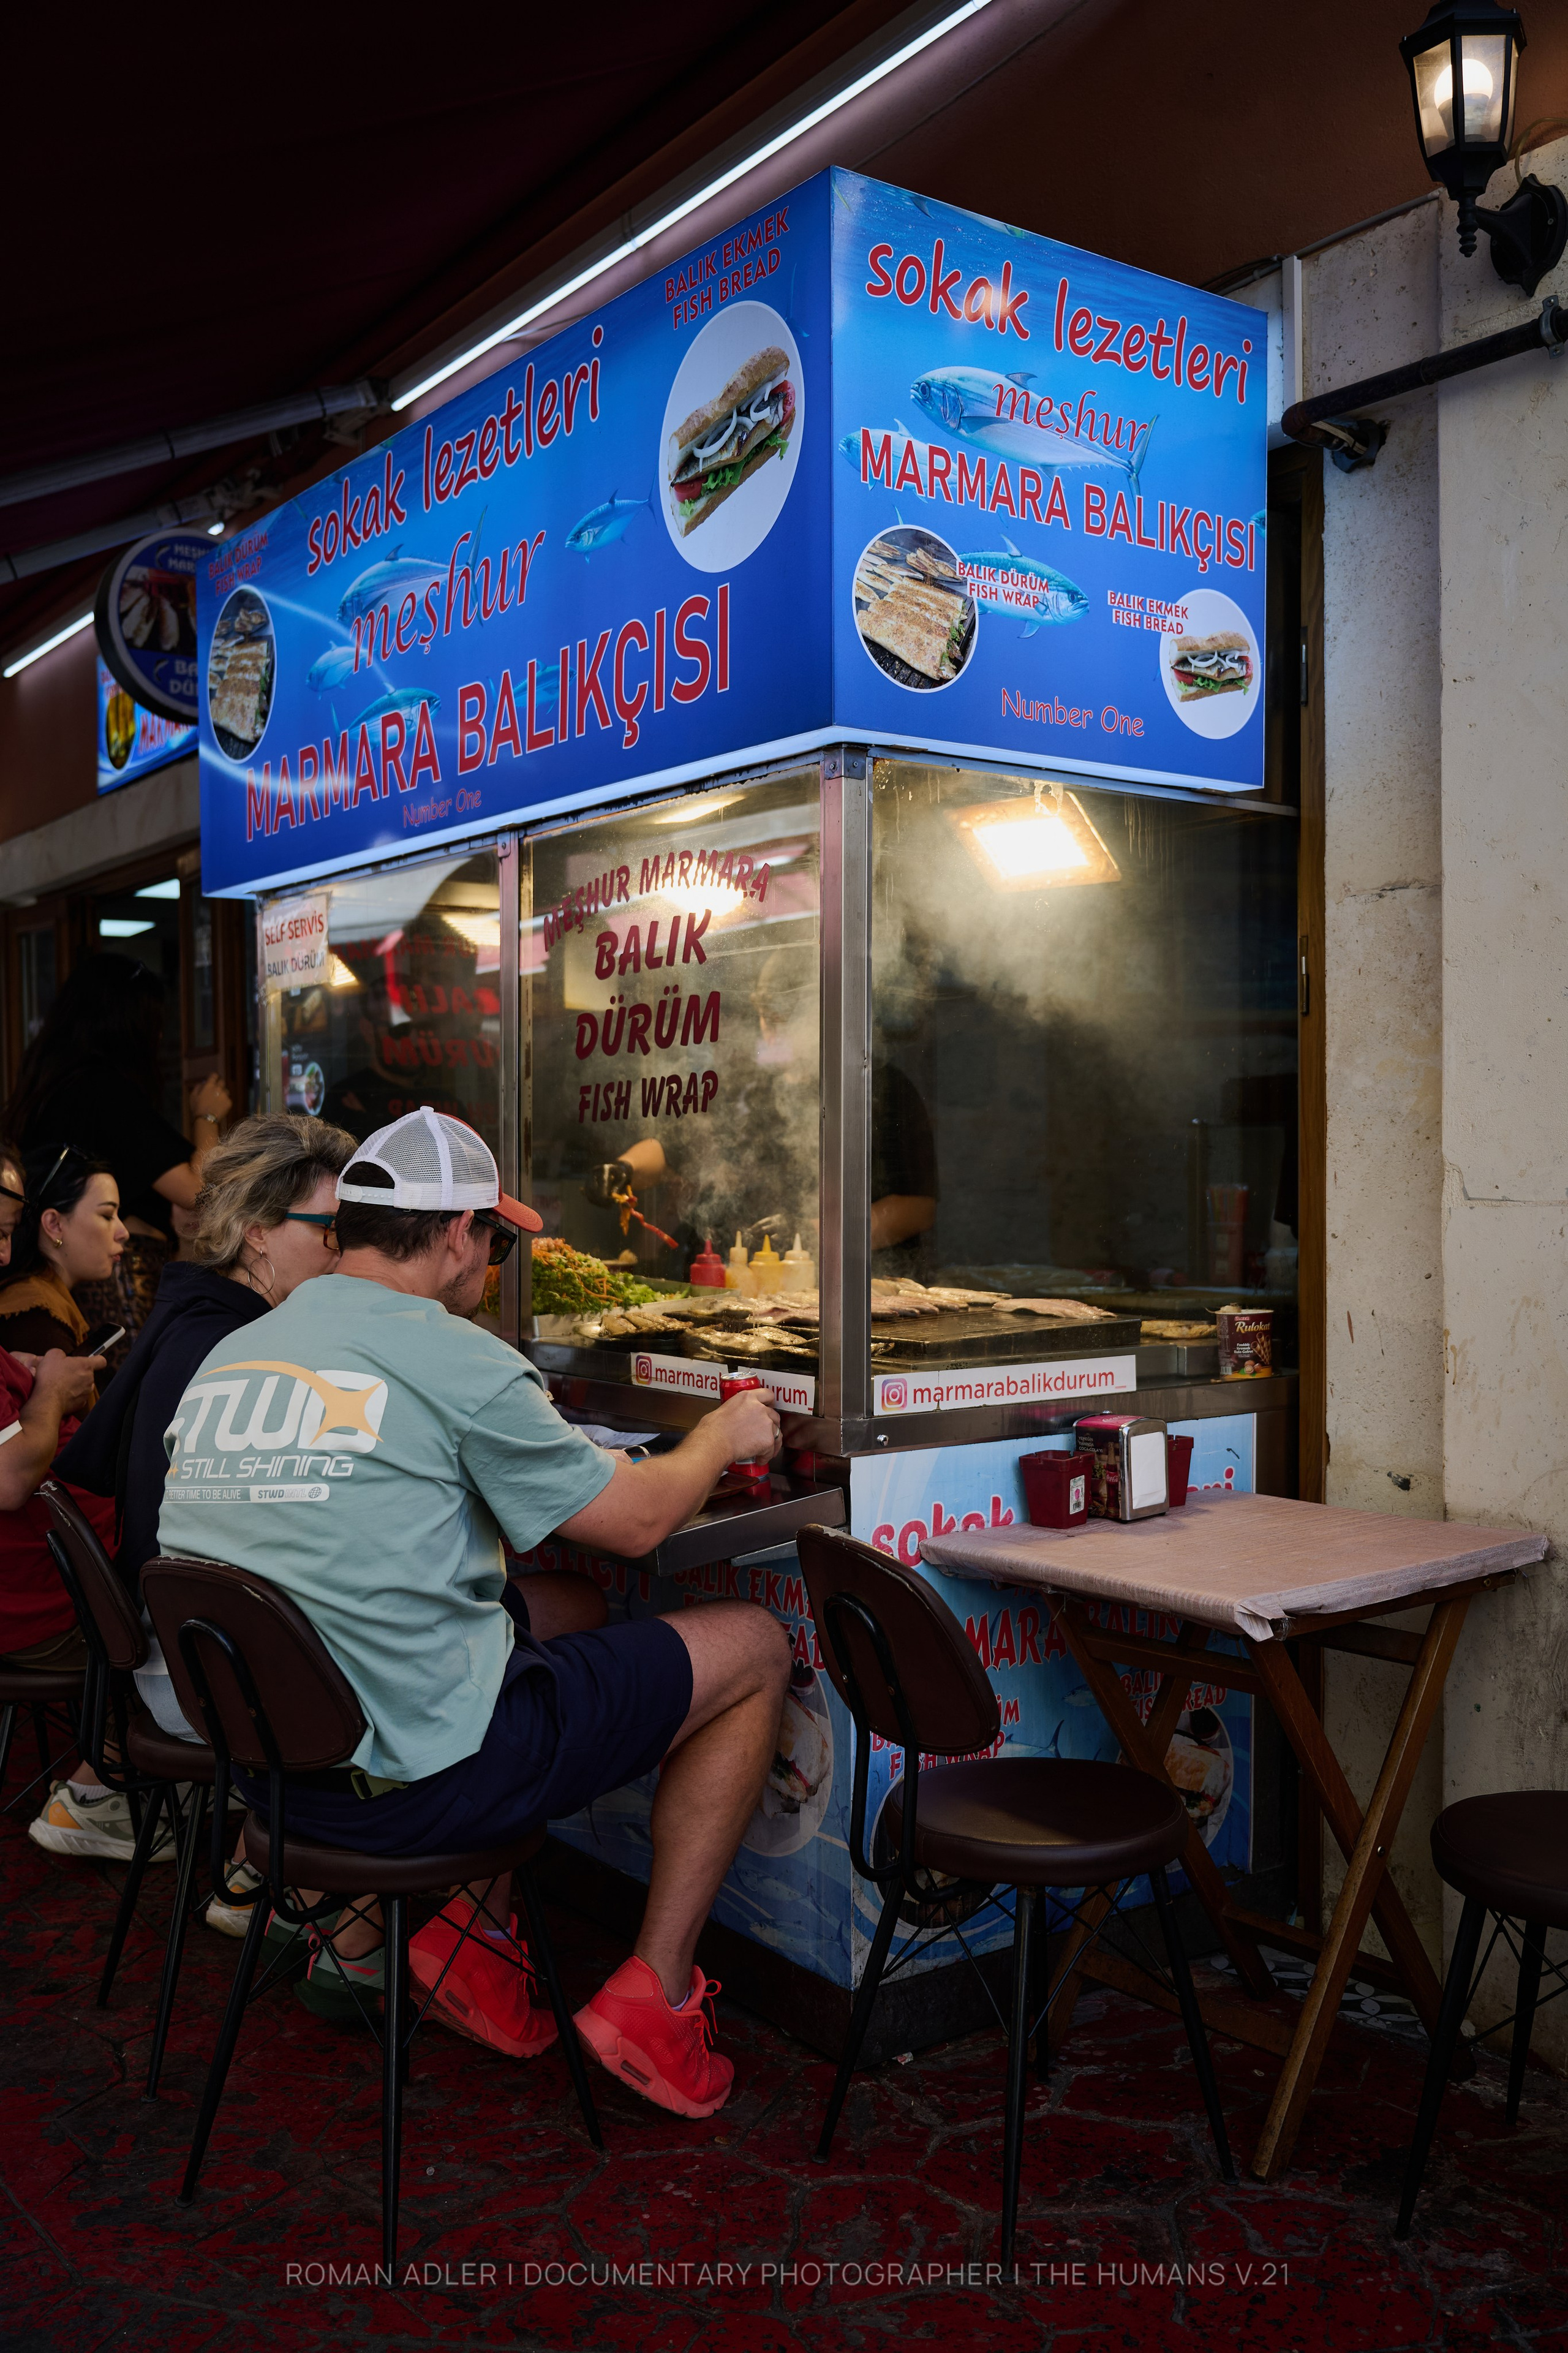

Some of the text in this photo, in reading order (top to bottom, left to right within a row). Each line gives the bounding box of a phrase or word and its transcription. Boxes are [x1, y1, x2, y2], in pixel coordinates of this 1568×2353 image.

[665, 206, 790, 303] BALIK EKMEK
[673, 247, 781, 330] FISH BREAD
[866, 239, 1253, 404] sokak lezetleri
[992, 382, 1148, 453] meşhur
[307, 325, 603, 576] sokak lezetleri
[861, 427, 1256, 573] MARMARA BALIKÇISI
[209, 551, 234, 579] BALIK
[235, 530, 269, 560] DÜRÜM
[216, 556, 263, 597] FISH WRAP
[956, 561, 1049, 594] BALIK DÜRÜM
[350, 530, 546, 676] meşhur
[968, 581, 1039, 608] FISH WRAP
[1107, 590, 1189, 619] BALIK EKMEK
[1112, 610, 1183, 635] FISH BREAD
[246, 583, 730, 843] MARMARA BALIKÇISI
[1001, 687, 1144, 737] Number One
[403, 788, 482, 829] Number One
[543, 849, 771, 953] MEŞHUR MARMARA
[265, 910, 325, 946] SELF SERVİS
[595, 909, 712, 980] BALIK
[266, 959, 289, 978] BALIK
[575, 984, 722, 1060] DÜRÜM
[578, 1070, 719, 1124] FISH WRAP
[1235, 1321, 1270, 1334] Rulokat
[181, 1456, 355, 1479] STILL SHINING
[169, 1490, 185, 1500] BETTER
[186, 1489, 200, 1500] TIME
[202, 1489, 211, 1499] TO
[213, 1489, 221, 1499] BE
[222, 1489, 241, 1499] ALIVE
